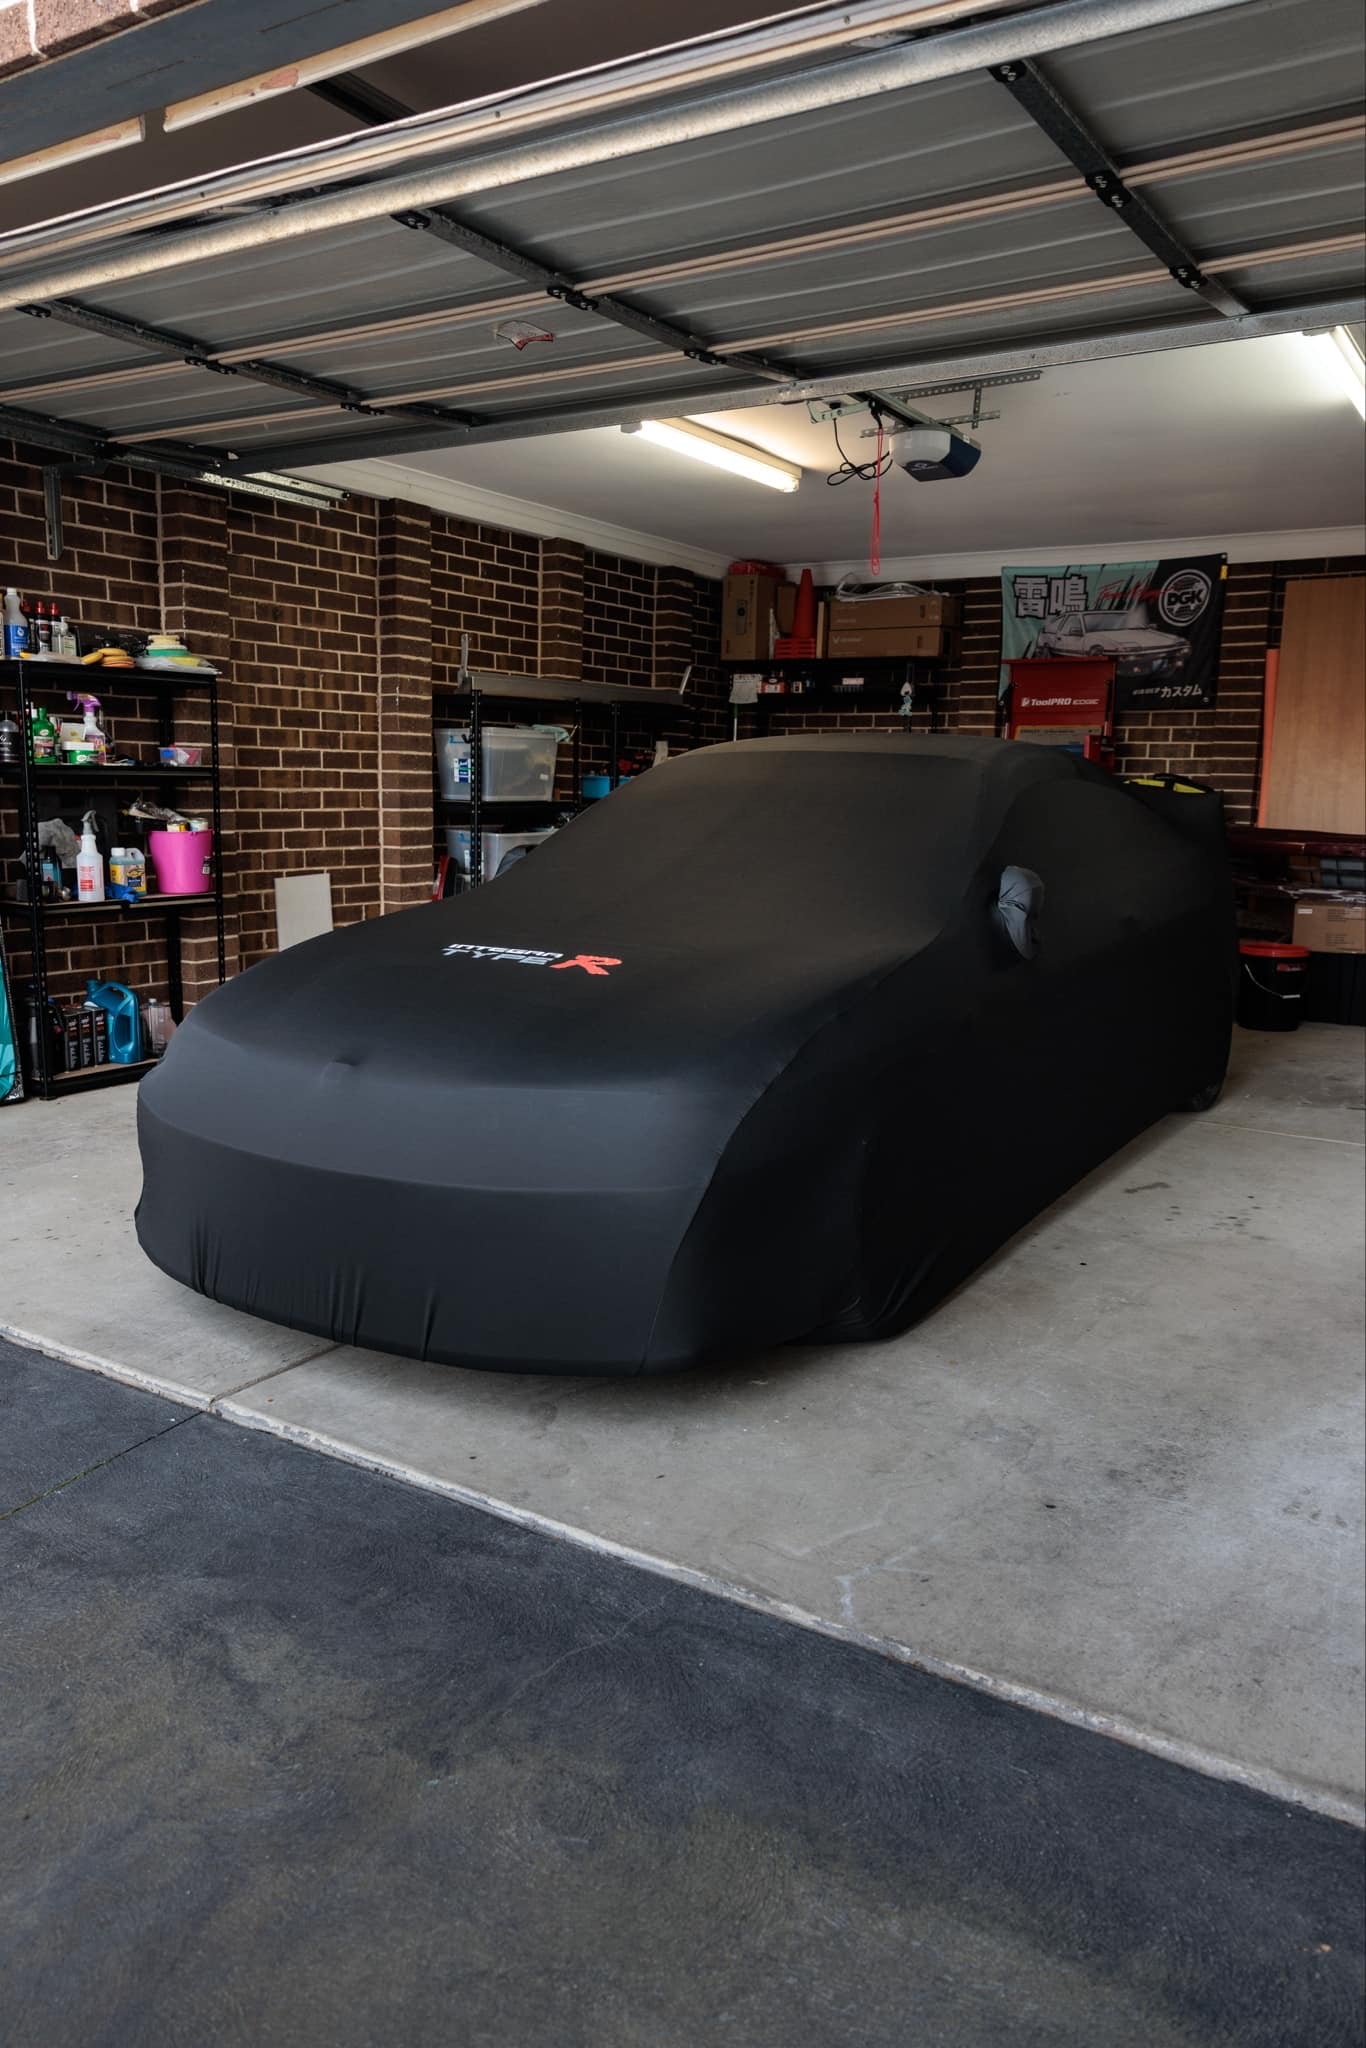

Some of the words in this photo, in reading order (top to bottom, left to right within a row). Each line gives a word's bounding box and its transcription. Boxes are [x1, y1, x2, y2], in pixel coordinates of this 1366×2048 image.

[1014, 574, 1087, 619] 雷鳴
[1167, 589, 1203, 606] DGK
[1160, 684, 1202, 698] カスタム
[1031, 697, 1072, 706] ToolPRO
[449, 943, 564, 958] INTEGRA
[441, 948, 555, 966] TYPE
[549, 954, 623, 976] R
